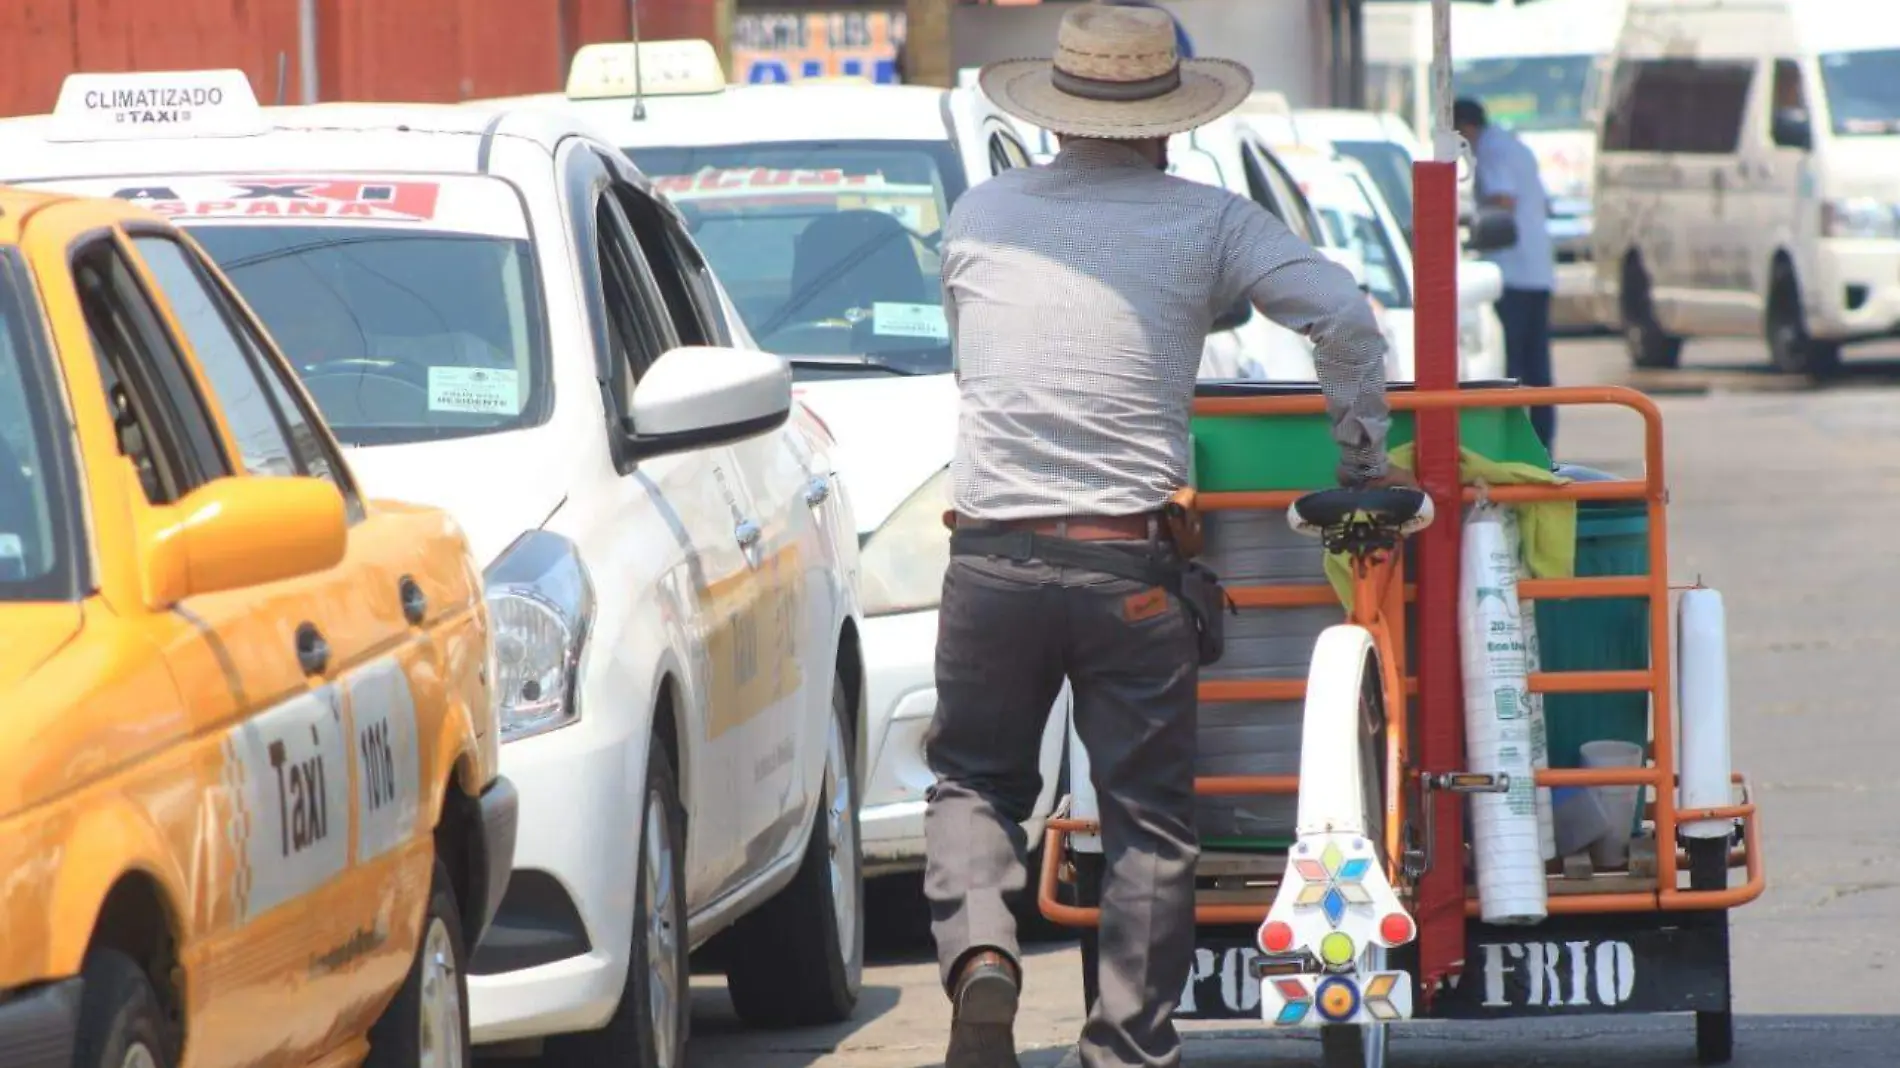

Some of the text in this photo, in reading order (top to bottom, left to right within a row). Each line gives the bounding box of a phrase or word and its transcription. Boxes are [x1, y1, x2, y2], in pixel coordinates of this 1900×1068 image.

[85, 88, 222, 109] CLIMATIZADO
[129, 110, 178, 123] TAXI
[1490, 620, 1506, 632] 20
[269, 722, 327, 858] Taxi
[1479, 940, 1635, 1006] FRIO
